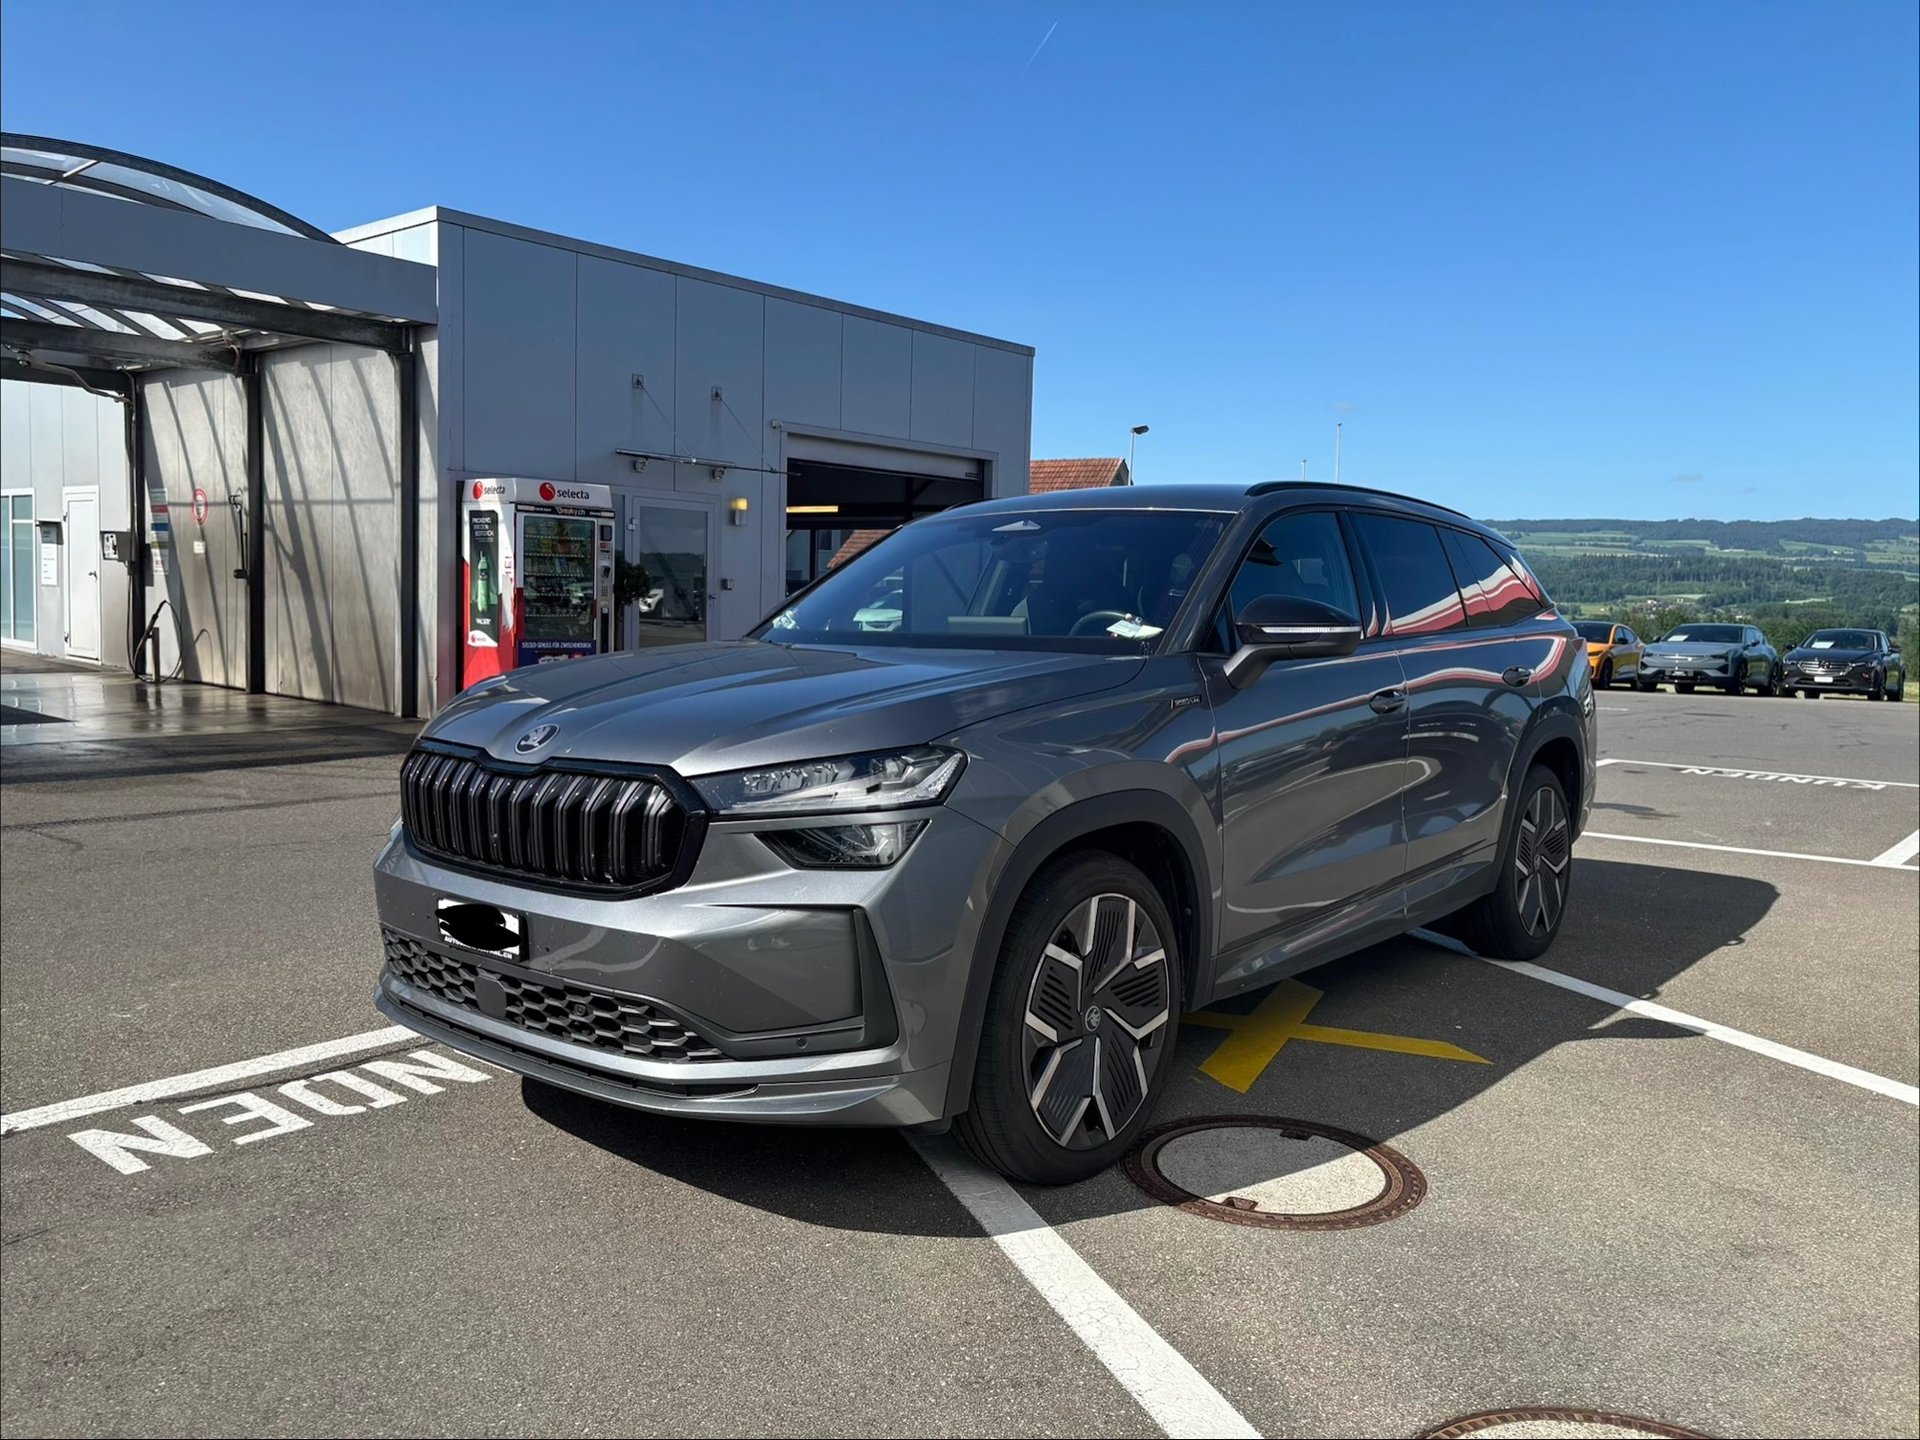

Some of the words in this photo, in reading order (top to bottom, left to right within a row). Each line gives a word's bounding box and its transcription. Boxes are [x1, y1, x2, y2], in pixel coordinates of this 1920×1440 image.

[483, 484, 506, 495] selecta
[556, 489, 590, 500] selecta
[1681, 767, 1888, 790] KUNDEN
[66, 1048, 494, 1176] NDEN
